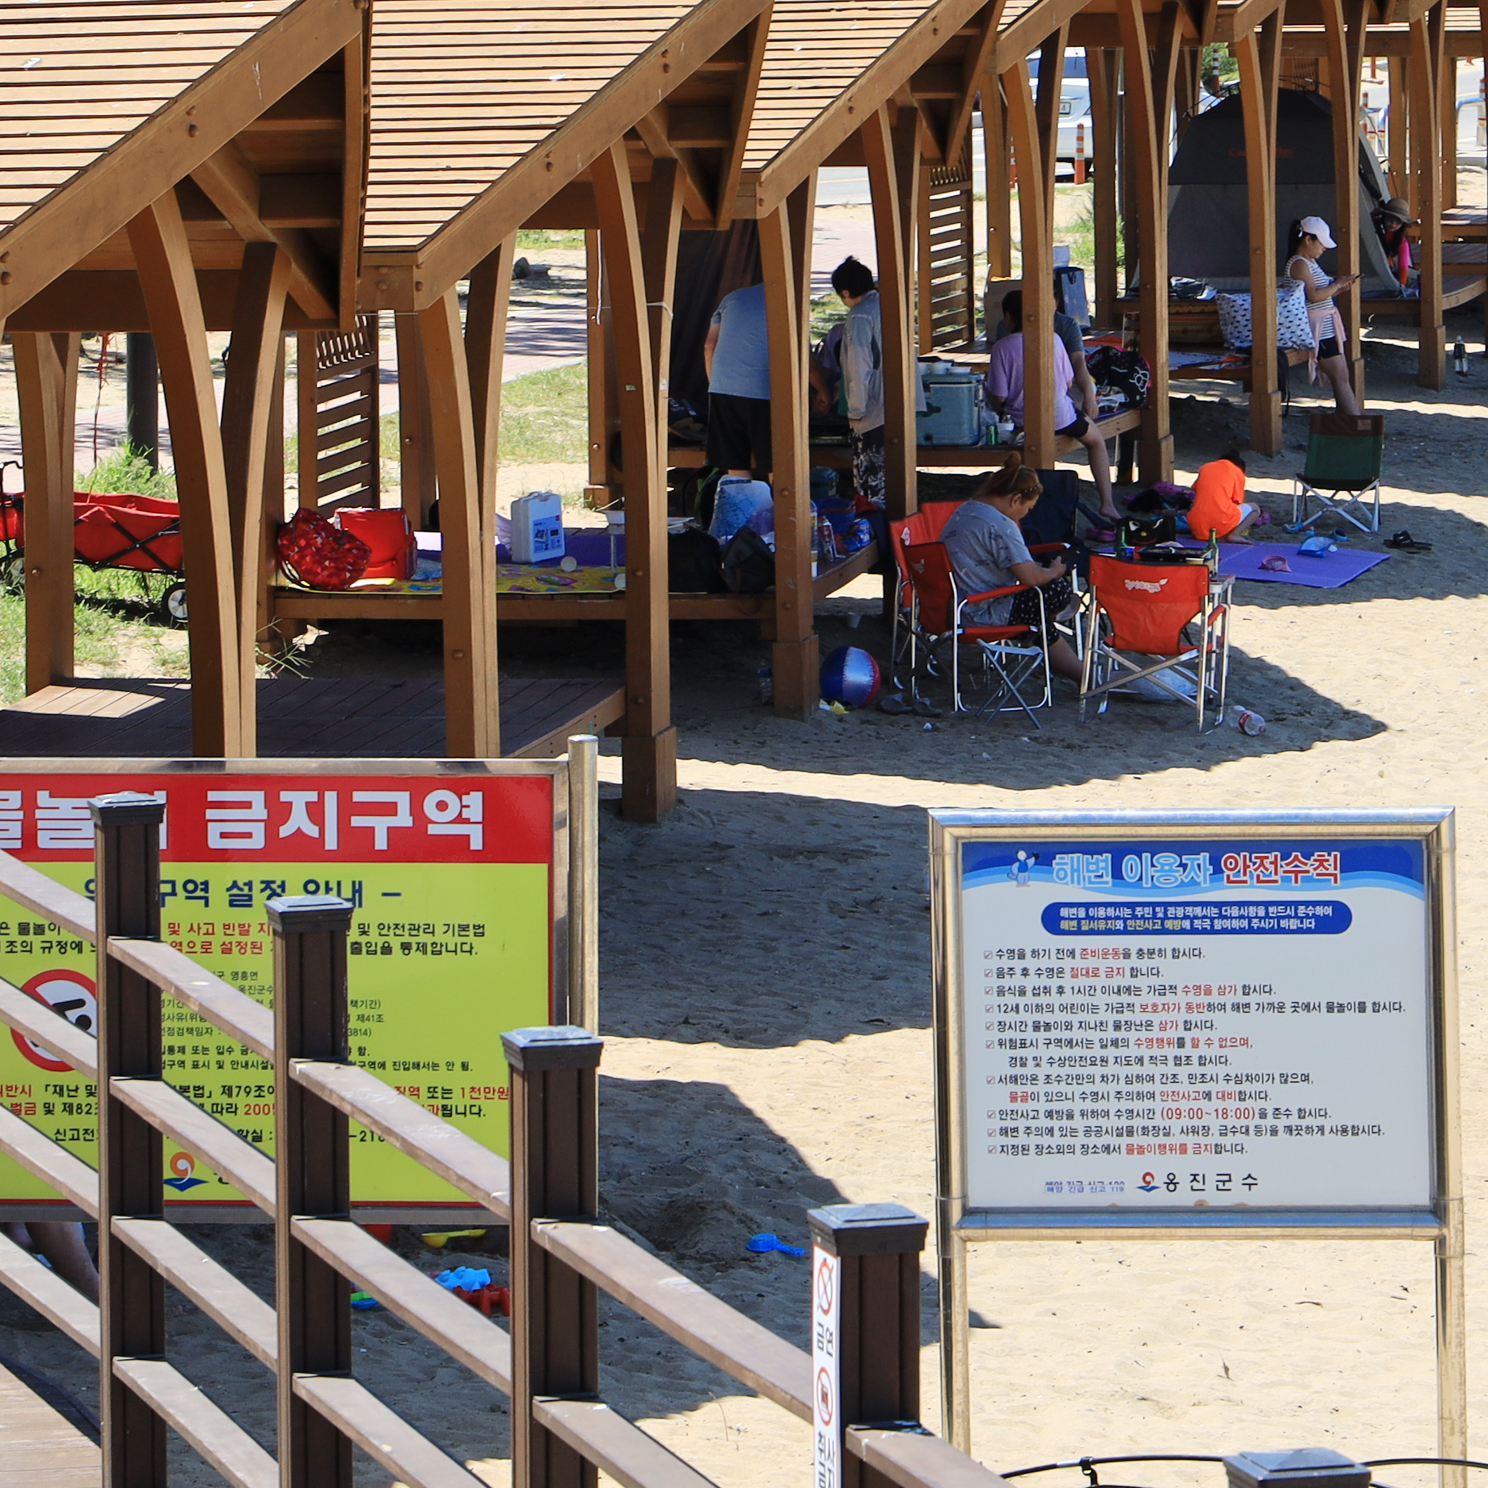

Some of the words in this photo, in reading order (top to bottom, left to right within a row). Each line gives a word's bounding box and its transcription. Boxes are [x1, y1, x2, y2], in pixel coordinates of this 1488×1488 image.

[205, 789, 484, 850] 금지구역
[1053, 852, 1112, 887] 해변
[1122, 852, 1213, 887] 이용자
[1221, 852, 1341, 887] 안전수칙
[226, 879, 286, 908] 설정
[168, 923, 181, 937] 및
[188, 923, 214, 937] 사고
[222, 923, 252, 937] 빈발
[358, 923, 371, 937] 및
[378, 923, 435, 937] 안전관리
[442, 923, 486, 937] 기본법
[40, 940, 84, 955] 규정에
[219, 941, 263, 955] 설정된
[350, 941, 393, 956] 출입을
[401, 941, 478, 956] 통제합니다.
[996, 948, 1026, 960] 수영을
[1031, 948, 1050, 960] 하기
[1055, 948, 1075, 960] 전에
[1080, 948, 1131, 960] 준비운동을
[1136, 948, 1166, 960] 충분히
[1171, 947, 1205, 959] 합시다.
[996, 967, 1016, 979] 음주
[1020, 967, 1030, 978] 후
[1034, 967, 1065, 979] 수영은
[1070, 967, 1100, 979] 절대로
[1105, 967, 1125, 978] 금지
[1130, 967, 1163, 978] 합니다.
[996, 985, 1027, 997] 음식을
[1032, 985, 1051, 997] 섭취
[1056, 985, 1066, 997] 후
[1071, 985, 1097, 996] 1시간
[1101, 985, 1142, 996] 이내에는
[1147, 985, 1177, 996] 가급적
[1182, 984, 1212, 996] 수영을
[1217, 985, 1237, 996] 삼가
[1242, 984, 1276, 996] 합시다.
[997, 1003, 1020, 1014] 12세
[1024, 1003, 1054, 1014] 이하의
[1059, 1003, 1100, 1014] 어린이는
[1105, 1002, 1135, 1014] 가급적
[1140, 1002, 1181, 1013] 보호자가
[1185, 1002, 1226, 1014] 동반하여
[1231, 1002, 1251, 1013] 해변
[1255, 1002, 1286, 1013] 가까운
[1290, 1002, 1321, 1013] 곳에서
[1326, 1001, 1367, 1013] 물놀이를
[1372, 1001, 1405, 1013] 합시다.
[356, 1014, 385, 1023] 제41조
[997, 1021, 1028, 1033] 장시간
[1032, 1020, 1073, 1032] 물놀이와
[1078, 1020, 1108, 1032] 지나친
[1113, 1020, 1154, 1032] 물장난은
[1159, 1020, 1178, 1031] 삼가
[1183, 1020, 1217, 1031] 합시다.
[998, 1038, 1038, 1050] 위험표시
[1043, 1038, 1095, 1049] 구역에서는
[1099, 1038, 1129, 1049] 일체의
[1134, 1037, 1186, 1049] 수영행위를
[1191, 1037, 1200, 1049] 할
[1204, 1037, 1214, 1048] 수
[190, 1045, 211, 1056] 또는
[215, 1045, 235, 1056] 입수
[190, 1060, 211, 1070] 표시
[215, 1060, 225, 1070] 및
[392, 1061, 440, 1071] 진입해서는
[446, 1061, 455, 1070] 안
[1009, 1056, 1028, 1068] 경찰
[1046, 1056, 1108, 1068] 수상안전요원
[1113, 1055, 1144, 1067] 지도에
[1149, 1055, 1168, 1067] 적극
[1173, 1055, 1193, 1067] 협조
[1198, 1055, 1231, 1067] 합시다.
[998, 1074, 1039, 1085] 서해안은
[1043, 1074, 1095, 1085] 조수간만의
[1100, 1074, 1120, 1085] 차가
[1124, 1073, 1155, 1085] 심하여
[1188, 1073, 1218, 1085] 만조시
[1223, 1073, 1275, 1085] 수심차이가
[427, 1086, 454, 1100] 또는
[1009, 1091, 1039, 1103] 물골이
[1044, 1091, 1074, 1103] 있으니
[1079, 1091, 1109, 1103] 수영시
[1114, 1091, 1155, 1102] 주의하여
[1160, 1090, 1212, 1102] 안전사고에
[1216, 1090, 1271, 1102] 대비합시다.
[43, 1102, 55, 1116] 및
[211, 1102, 239, 1116] 따라
[999, 1109, 1040, 1121] 안전사고
[1044, 1109, 1074, 1121] 예방을
[1080, 1109, 1110, 1120] 위하여
[1114, 1108, 1155, 1120] 수영시간
[1272, 1108, 1293, 1119] 준수
[1297, 1108, 1331, 1119] 합시다.
[999, 1126, 1019, 1138] 해변
[1058, 1126, 1079, 1137] 있는
[1219, 1125, 1249, 1137] 급수대
[1283, 1125, 1325, 1136] 깨끗하게
[1329, 1124, 1384, 1137] 사용합시다.
[1000, 1144, 1030, 1156] 지정된
[1035, 1144, 1075, 1156] 장소외의
[1080, 1144, 1121, 1156] 장소에서
[1126, 1143, 1188, 1155] 물놀이행위를
[1192, 1143, 1247, 1155] 금지합니다.
[816, 1321, 834, 1358] 금연
[818, 1430, 836, 1467] 취사
